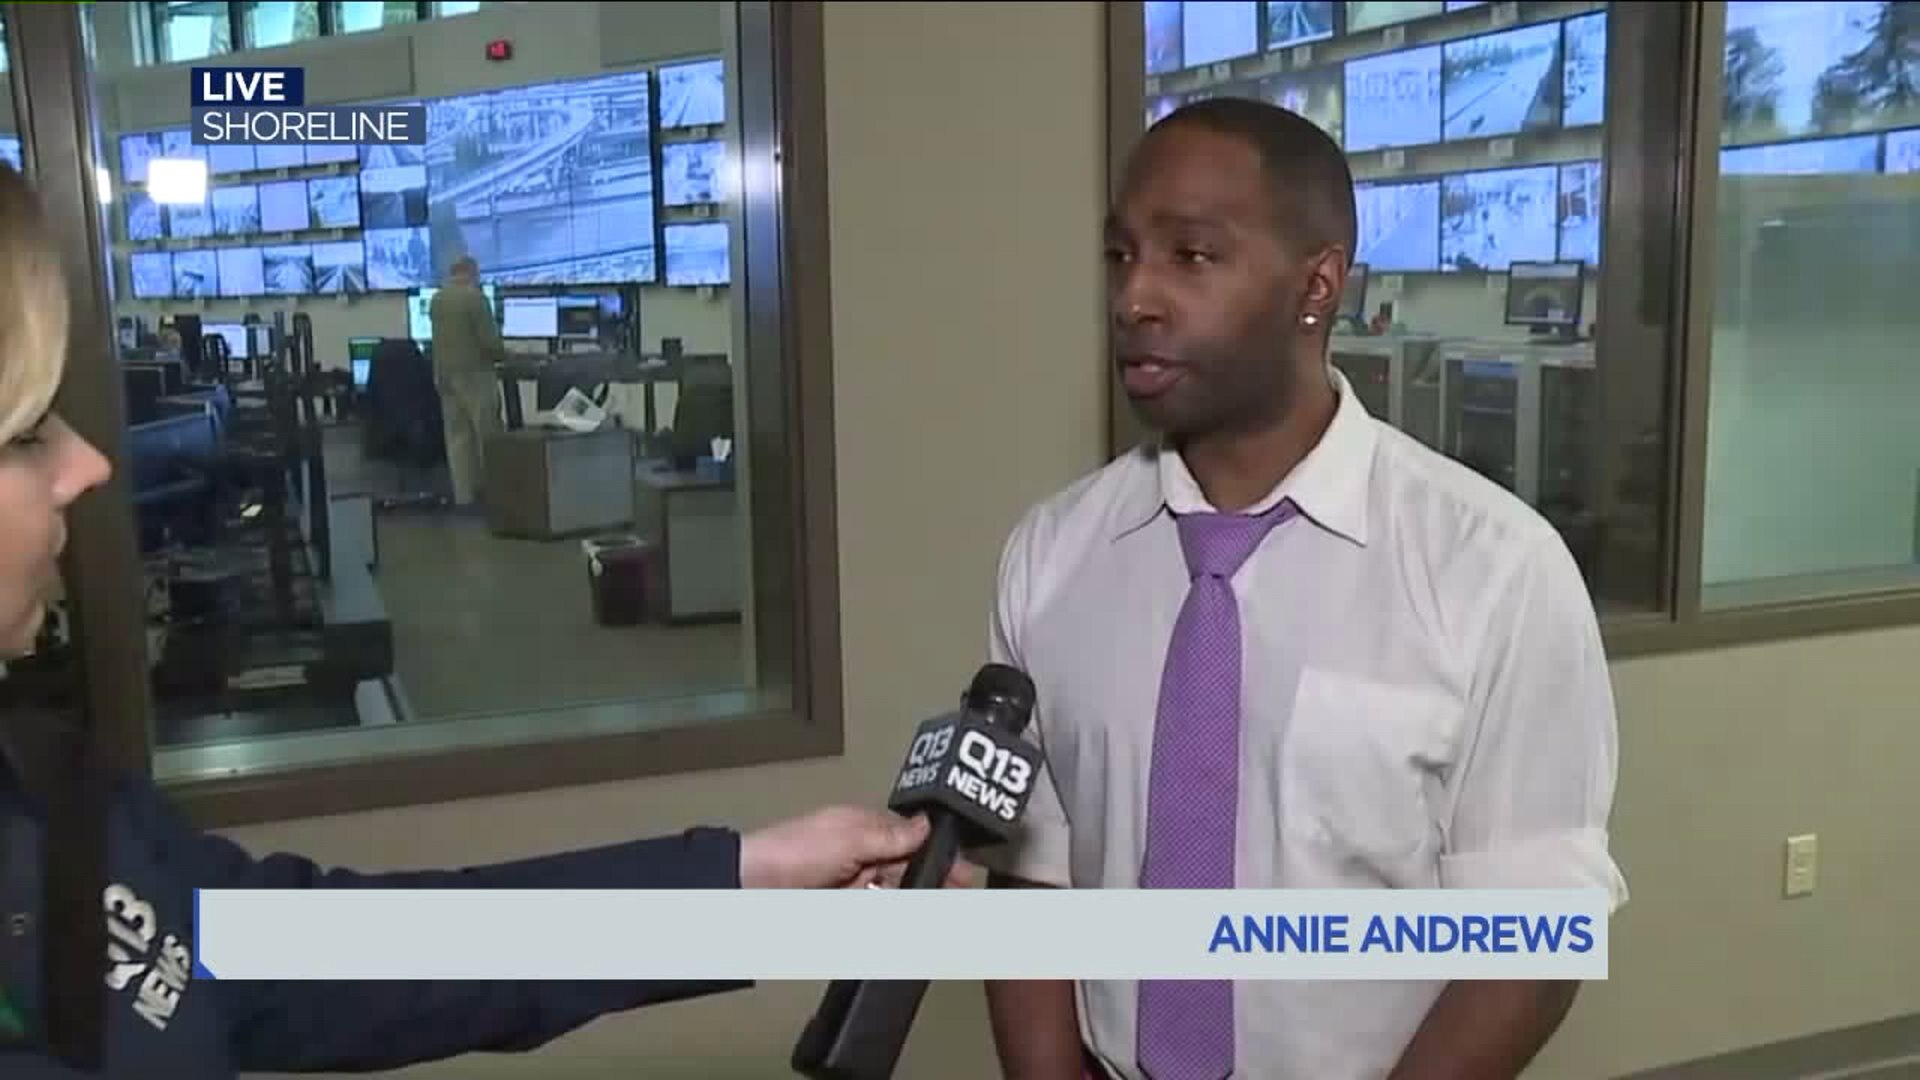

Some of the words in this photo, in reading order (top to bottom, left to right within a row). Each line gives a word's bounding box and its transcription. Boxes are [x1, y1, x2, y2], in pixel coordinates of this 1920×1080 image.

[947, 765, 1018, 820] NEWS
[959, 730, 1031, 794] Q13
[131, 935, 190, 1031] NEWS
